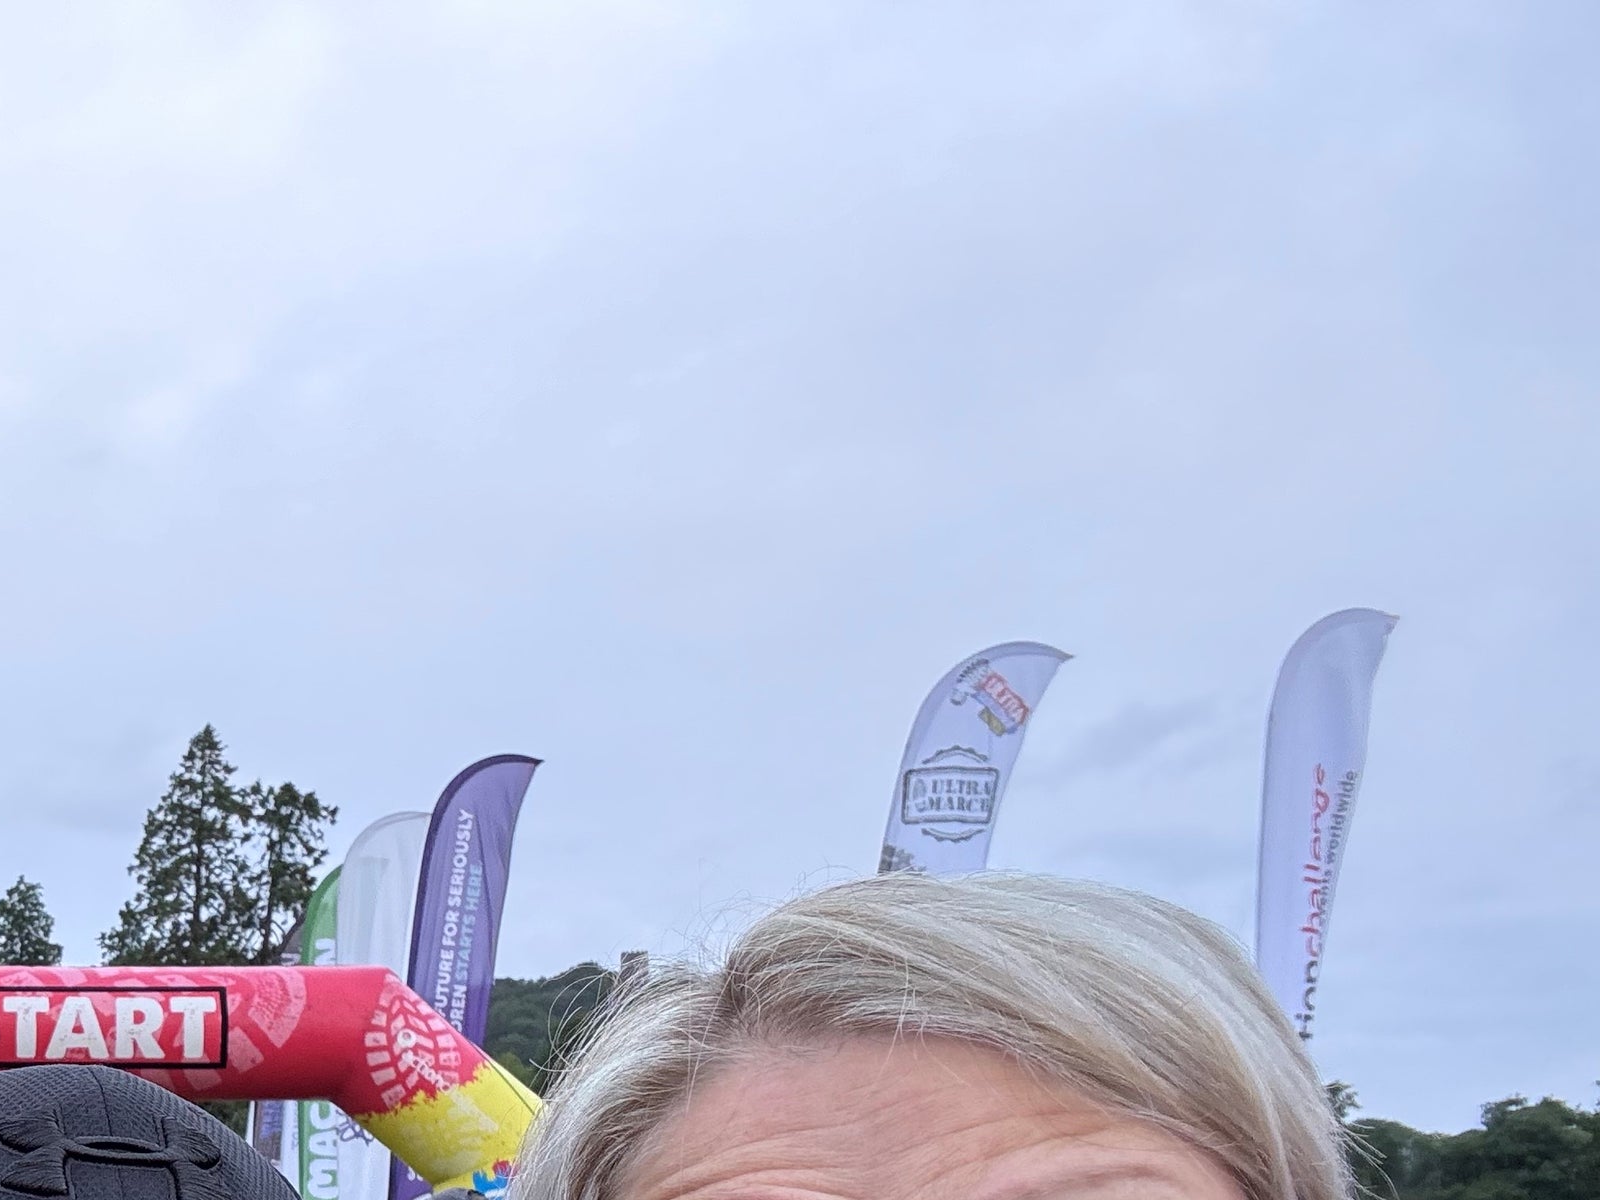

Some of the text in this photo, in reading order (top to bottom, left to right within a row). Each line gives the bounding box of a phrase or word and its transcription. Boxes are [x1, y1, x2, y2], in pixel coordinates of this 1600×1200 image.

[1326, 769, 1357, 865] worldwide
[448, 807, 475, 906] SERIOUSLY
[465, 862, 484, 912] HERE
[442, 907, 461, 947] FOR
[454, 913, 477, 983] STARTS
